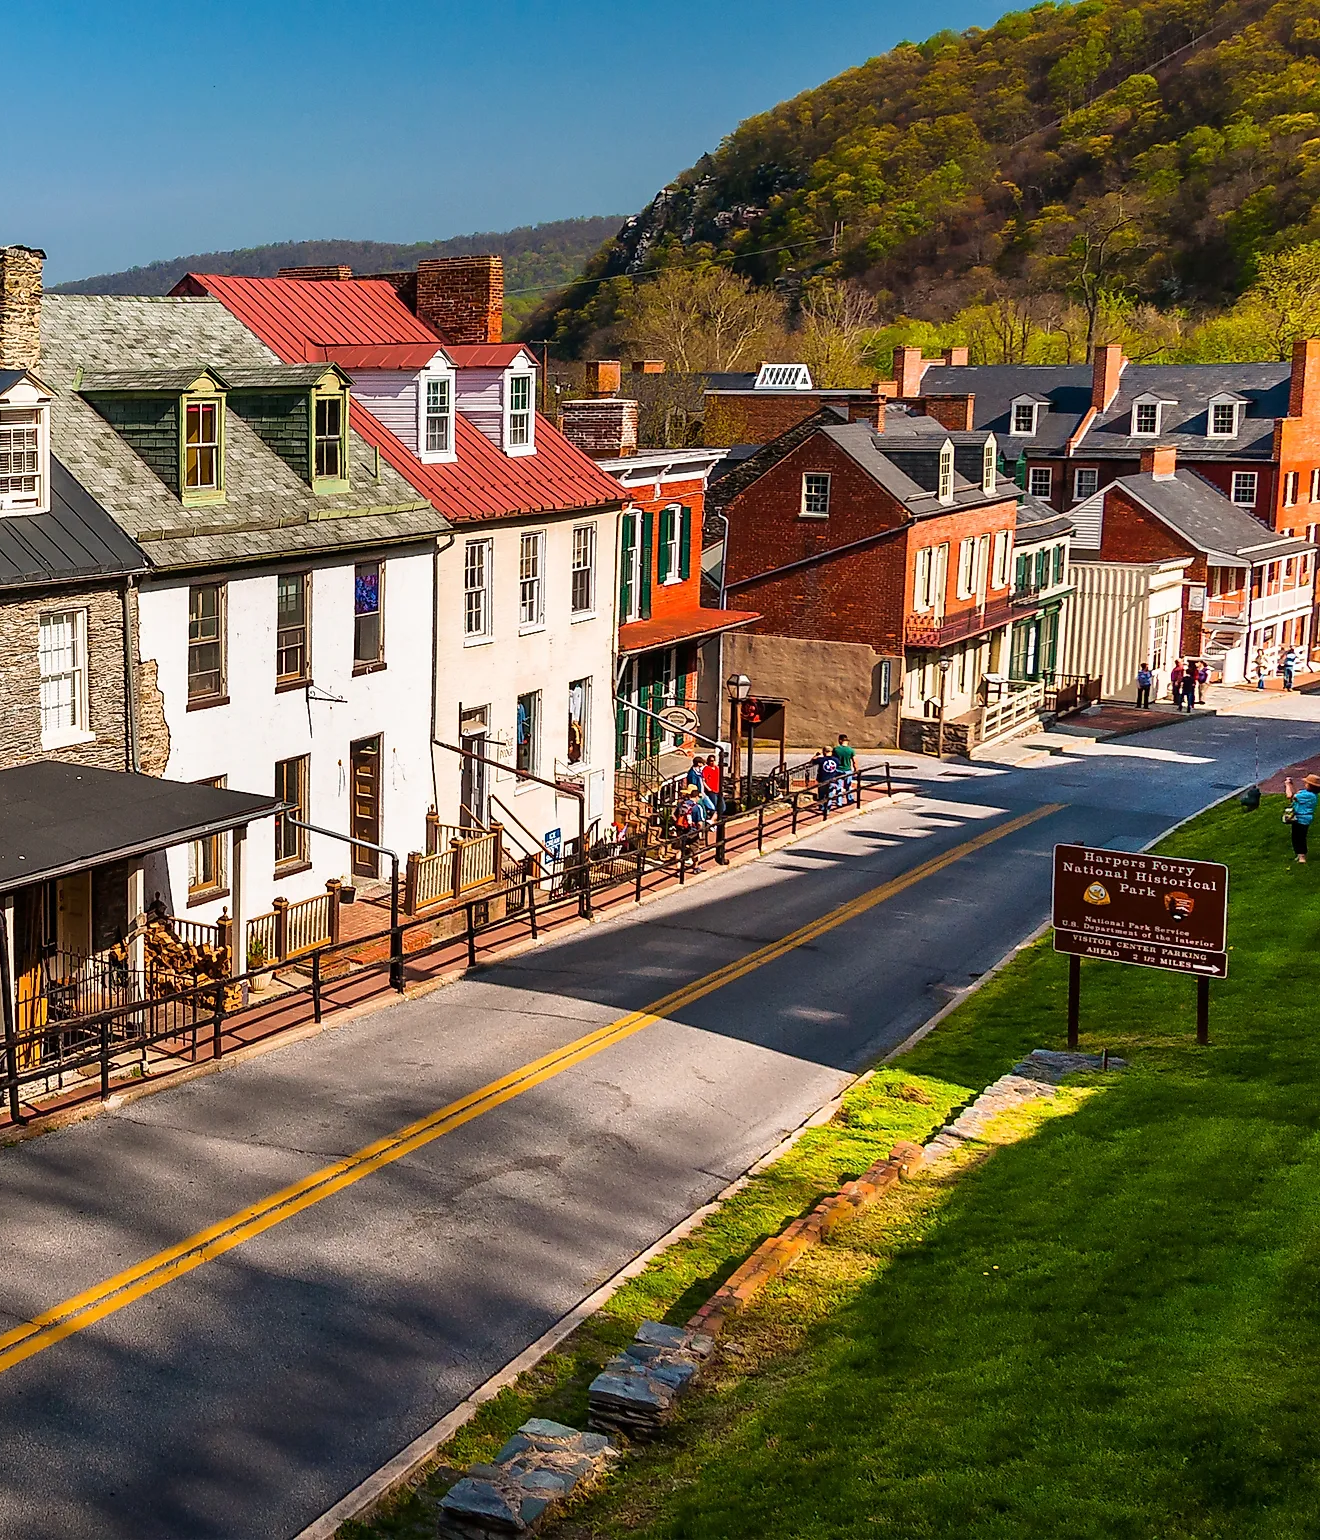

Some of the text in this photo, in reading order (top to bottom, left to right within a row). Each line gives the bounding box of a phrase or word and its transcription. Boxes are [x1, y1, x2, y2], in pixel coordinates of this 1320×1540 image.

[1062, 861, 1217, 891] National Historical
[1084, 851, 1196, 877] Harpers Ferry
[1119, 883, 1157, 897] Park
[1062, 919, 1079, 928] U.S.
[1083, 923, 1138, 937] Department
[1155, 934, 1171, 942] the
[1175, 936, 1215, 948] Interior
[1084, 915, 1190, 937] National Park Service
[1072, 934, 1208, 961] VISITOR CENTER PARKING
[1086, 946, 1120, 957] AHEAD
[1160, 958, 1192, 969] MILES
